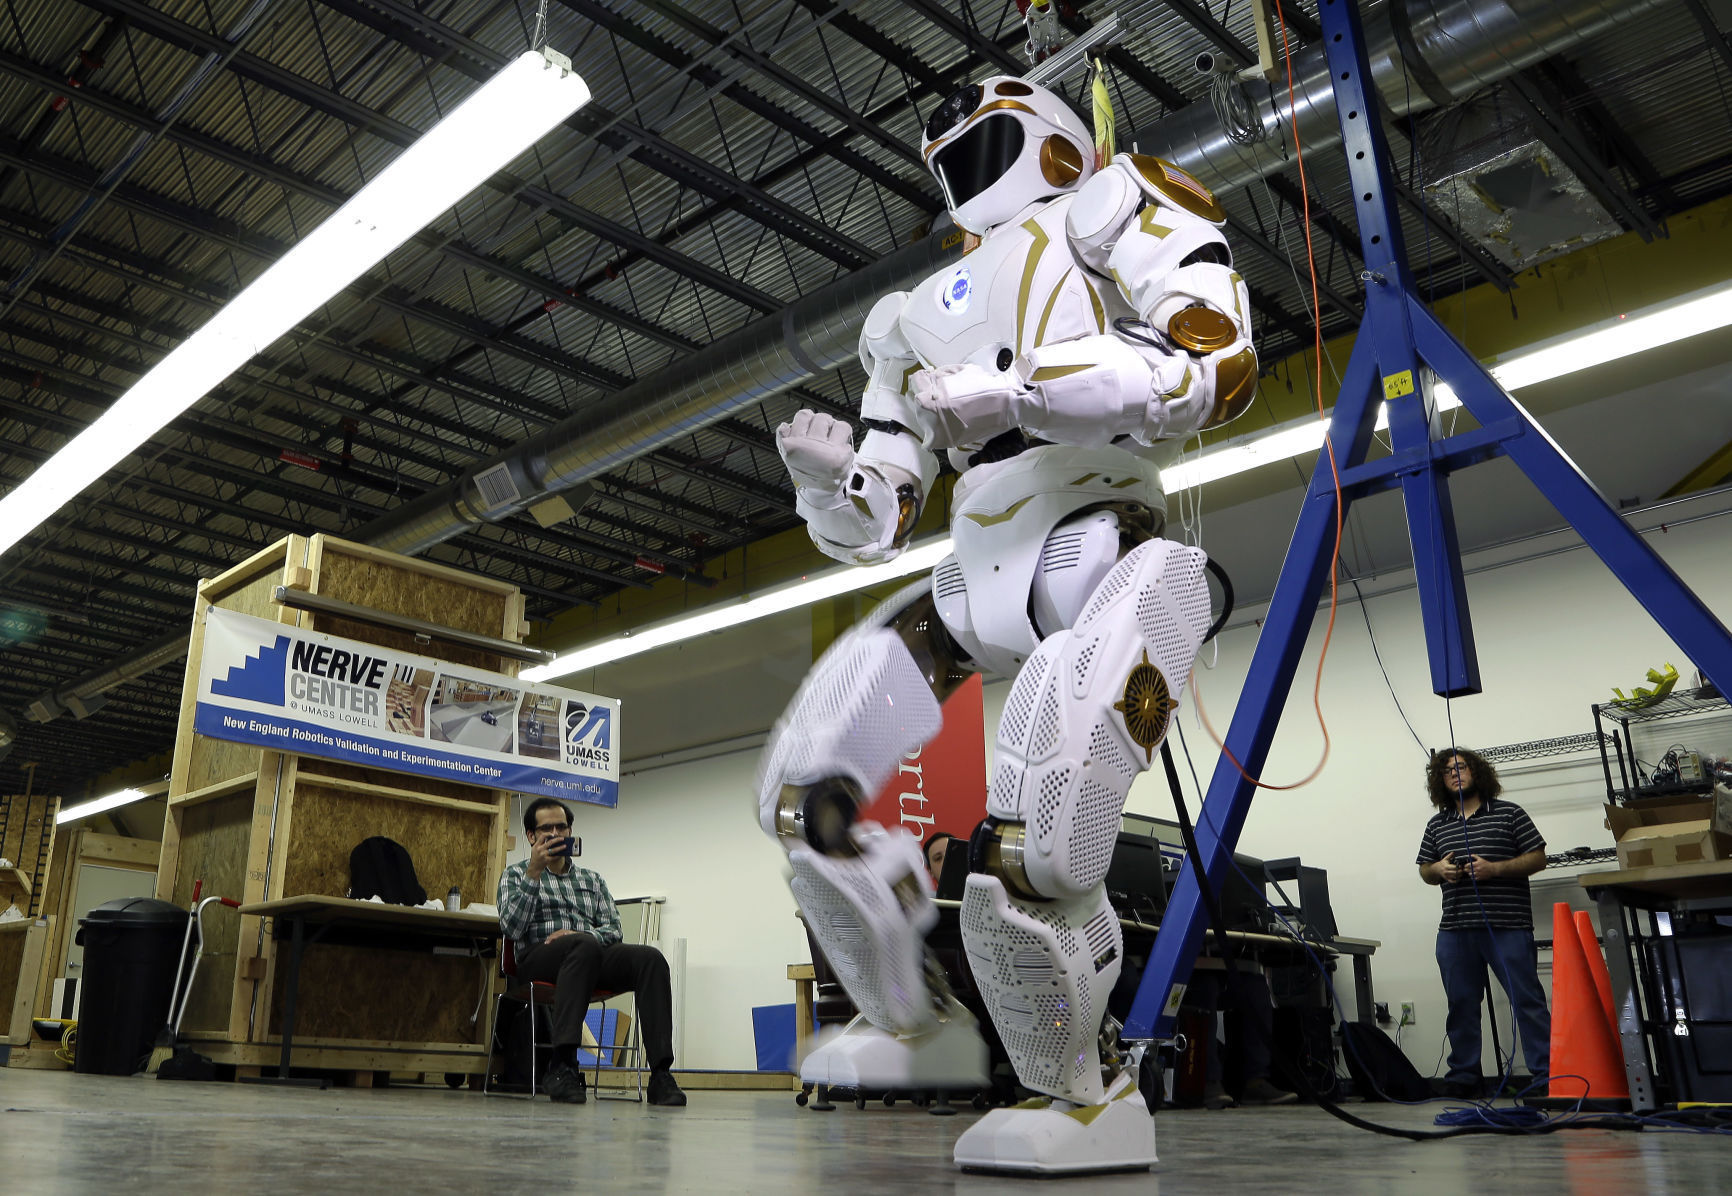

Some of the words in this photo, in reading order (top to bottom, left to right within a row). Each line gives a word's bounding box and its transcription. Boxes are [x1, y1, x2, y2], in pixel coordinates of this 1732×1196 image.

[292, 640, 387, 689] NERVE
[291, 673, 379, 716] CENTER
[301, 704, 335, 719] UMASS
[340, 713, 378, 728] LOWELL
[223, 716, 247, 729] New
[249, 720, 289, 737] England
[292, 728, 334, 745] Robotics
[335, 737, 380, 756] Validation
[382, 750, 399, 760] and
[401, 751, 472, 773] Experimentation
[473, 764, 502, 778] Center
[566, 745, 610, 762] UMASS
[566, 756, 609, 771] LOWELL
[541, 777, 601, 794] nerve.uml.edu
